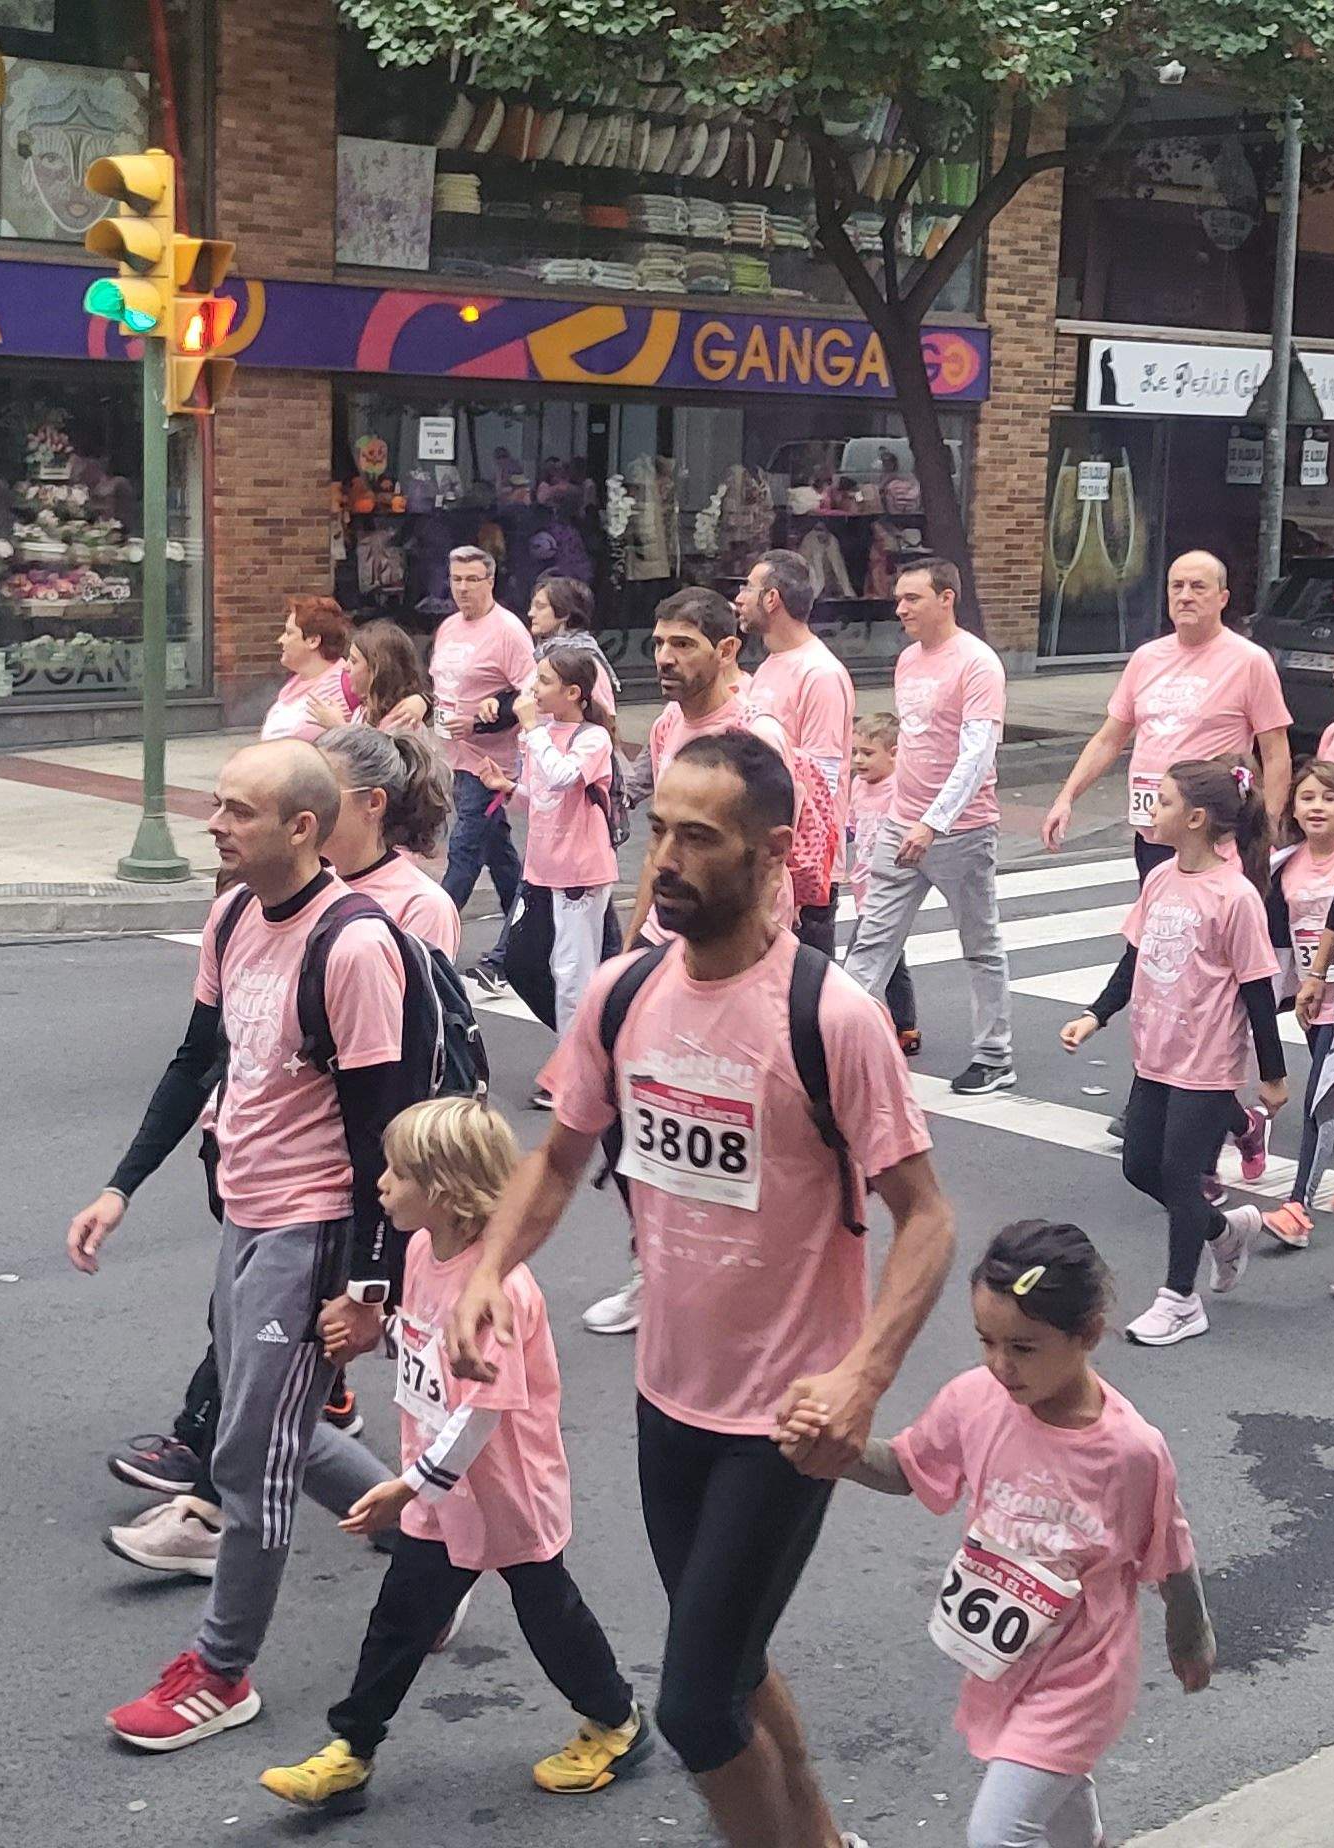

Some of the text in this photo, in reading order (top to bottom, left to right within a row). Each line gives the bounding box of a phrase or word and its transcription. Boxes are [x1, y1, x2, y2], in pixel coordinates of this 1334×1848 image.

[693, 320, 890, 388] GANGA
[1173, 362, 1230, 398] Petit
[1132, 791, 1155, 812] 30
[635, 1107, 748, 1174] 3808
[941, 1568, 1030, 1654] 260
[1004, 1578, 1020, 1597] EL
[1022, 1587, 1063, 1618] CÁNC
